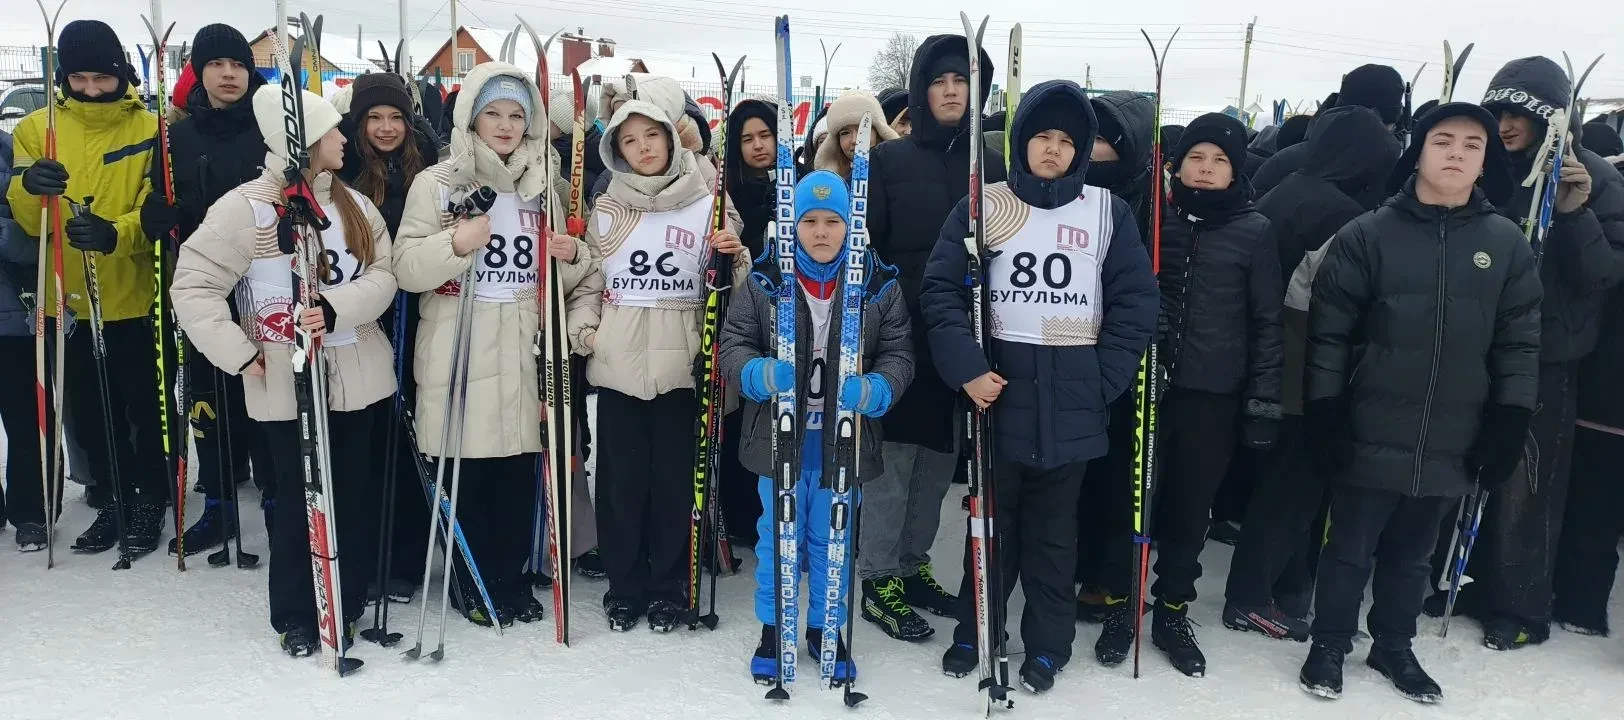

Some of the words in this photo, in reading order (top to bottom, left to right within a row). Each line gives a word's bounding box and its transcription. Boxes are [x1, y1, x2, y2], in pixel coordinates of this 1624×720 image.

[281, 72, 301, 169] ADOS
[777, 168, 795, 274] BRADOS
[847, 179, 869, 285] BRADOS
[665, 224, 696, 249] ГТО
[1056, 223, 1090, 249] ГТО
[484, 233, 533, 269] 88
[628, 249, 680, 277] 86
[475, 270, 540, 284] УГУЛЬМ
[612, 277, 694, 291] БУГУЛЬМА
[1009, 251, 1072, 290] 80
[990, 289, 1088, 307] БУГУЛЬМА
[264, 329, 284, 341] ГТО
[546, 359, 554, 408] NORDWAY
[781, 563, 794, 609] TOUR
[826, 567, 841, 611] TOUR
[782, 612, 795, 635] XT
[824, 612, 838, 634] XT
